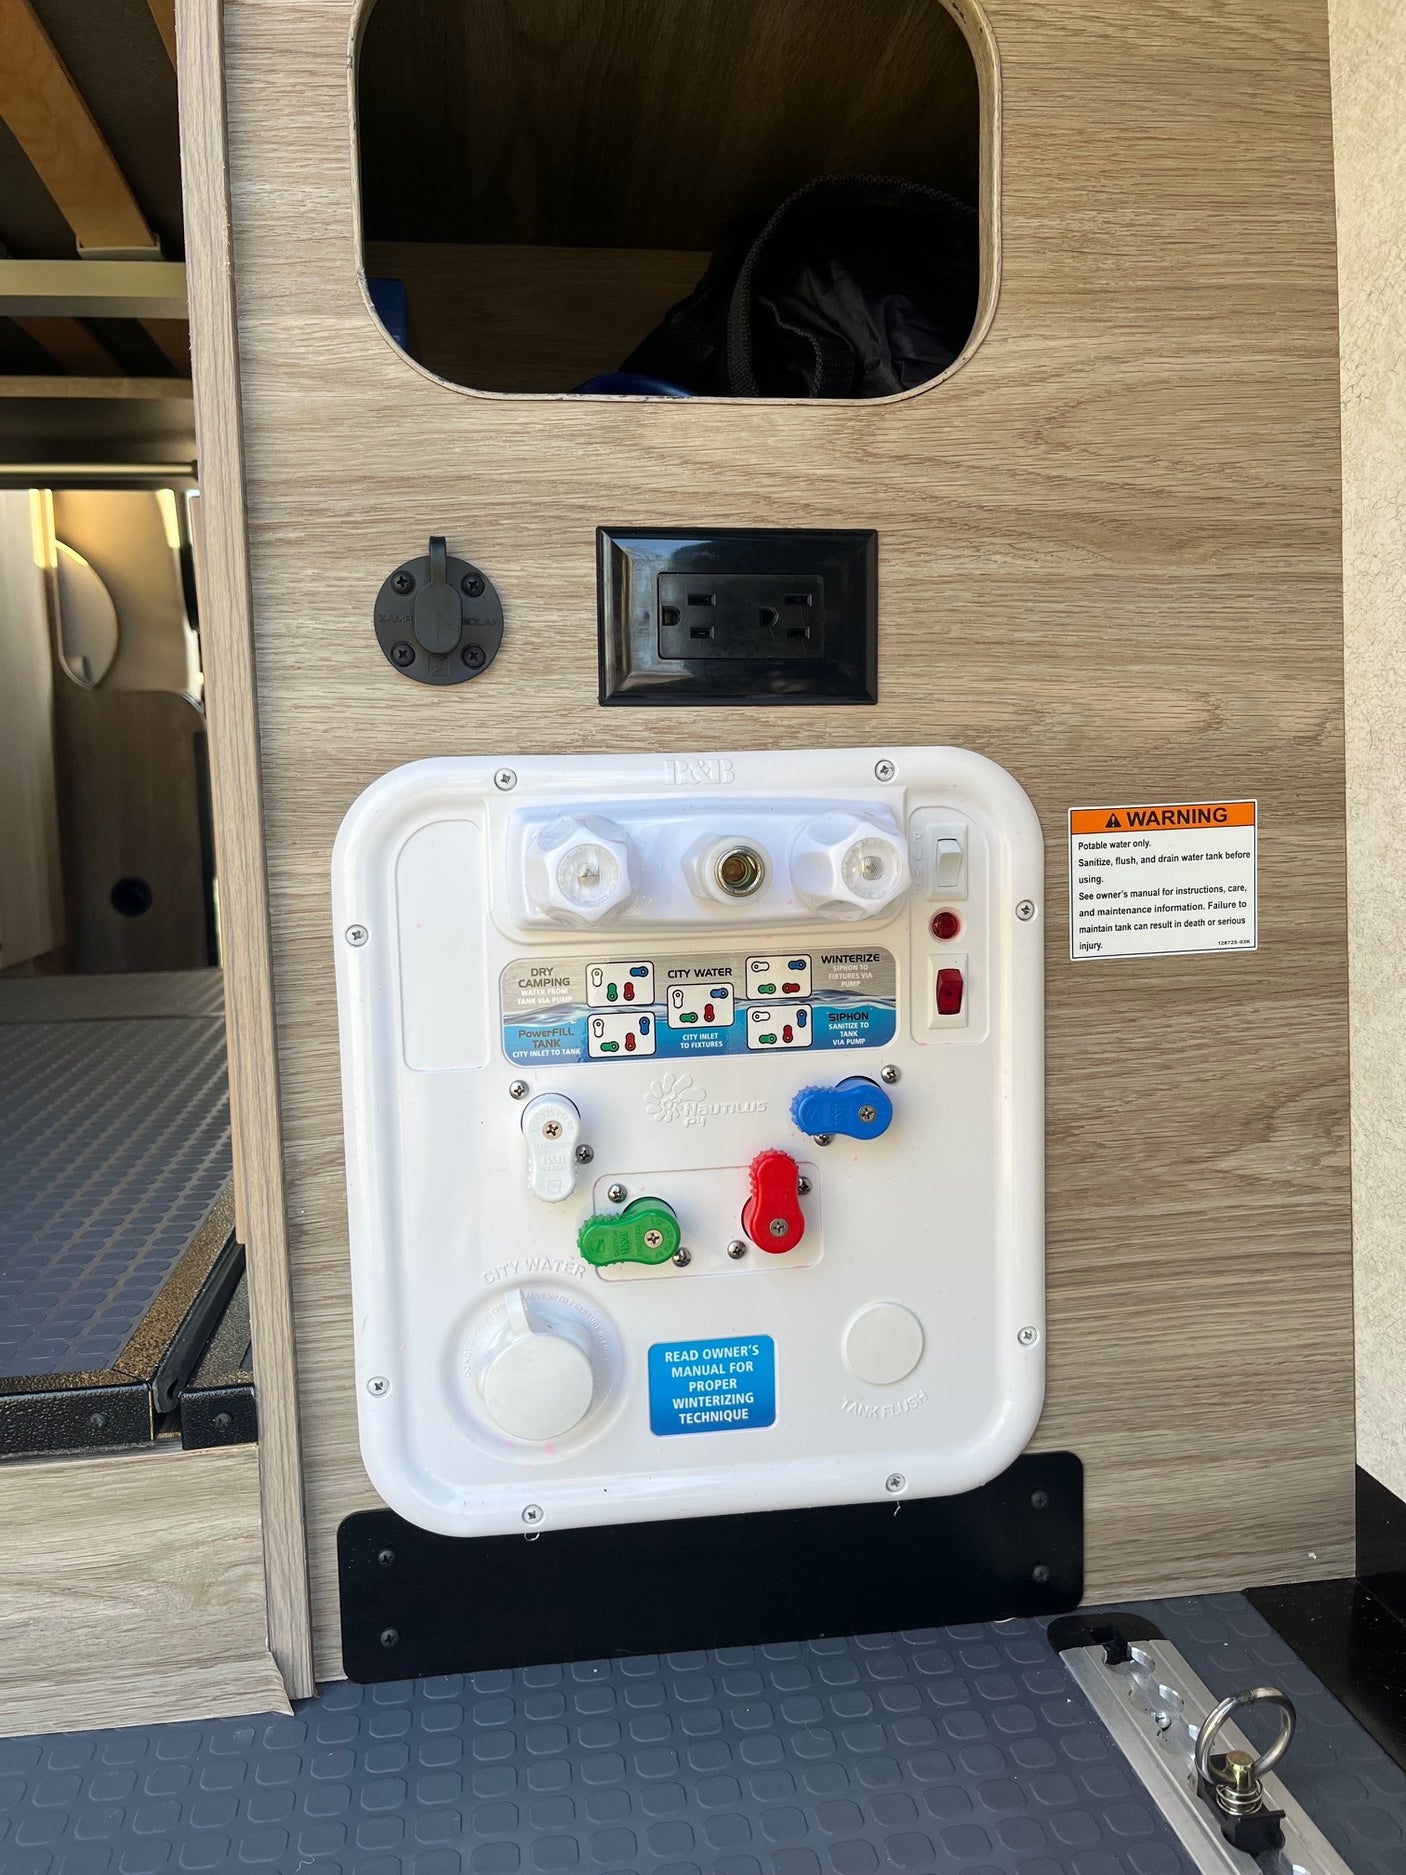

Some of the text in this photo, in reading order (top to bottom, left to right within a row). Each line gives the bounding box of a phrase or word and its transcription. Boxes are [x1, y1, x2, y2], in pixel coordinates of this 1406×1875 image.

[1127, 808, 1228, 827] WARNING
[1078, 841, 1107, 850] Potable
[1133, 839, 1151, 849] only.
[1078, 850, 1250, 867] Sanitize, flush, and drain water tank before
[1078, 875, 1104, 884] using.
[1079, 885, 1247, 900] See owner's manual for instructions, care,
[1079, 908, 1095, 917] and
[1097, 906, 1152, 916] maintenance
[1154, 903, 1205, 913] information.
[1208, 901, 1236, 910] Failure
[1079, 924, 1113, 934] maintain
[1115, 923, 1132, 931] tank
[1150, 921, 1172, 930] result
[1174, 920, 1182, 928] in
[1184, 919, 1205, 928] death
[1218, 917, 1245, 926] serious
[1079, 941, 1103, 951] injury.
[821, 953, 880, 964] WINTERIZE
[531, 967, 554, 977] DRY
[668, 968, 732, 979] CITY WATER
[518, 977, 570, 988] CAMPING
[828, 1012, 869, 1021] SIPHON
[828, 1022, 859, 1030] SANITIZE
[532, 1039, 561, 1048] TANK
[482, 1257, 586, 1285] CITY WATER
[665, 1345, 759, 1363] READ OWNER'S
[672, 1361, 753, 1378] MANUAL FOR
[689, 1378, 737, 1392] PROPER
[672, 1392, 754, 1409] WINTERIZING
[841, 1389, 929, 1419] TANK FLUSH
[679, 1409, 748, 1424] TECHNIQUE
